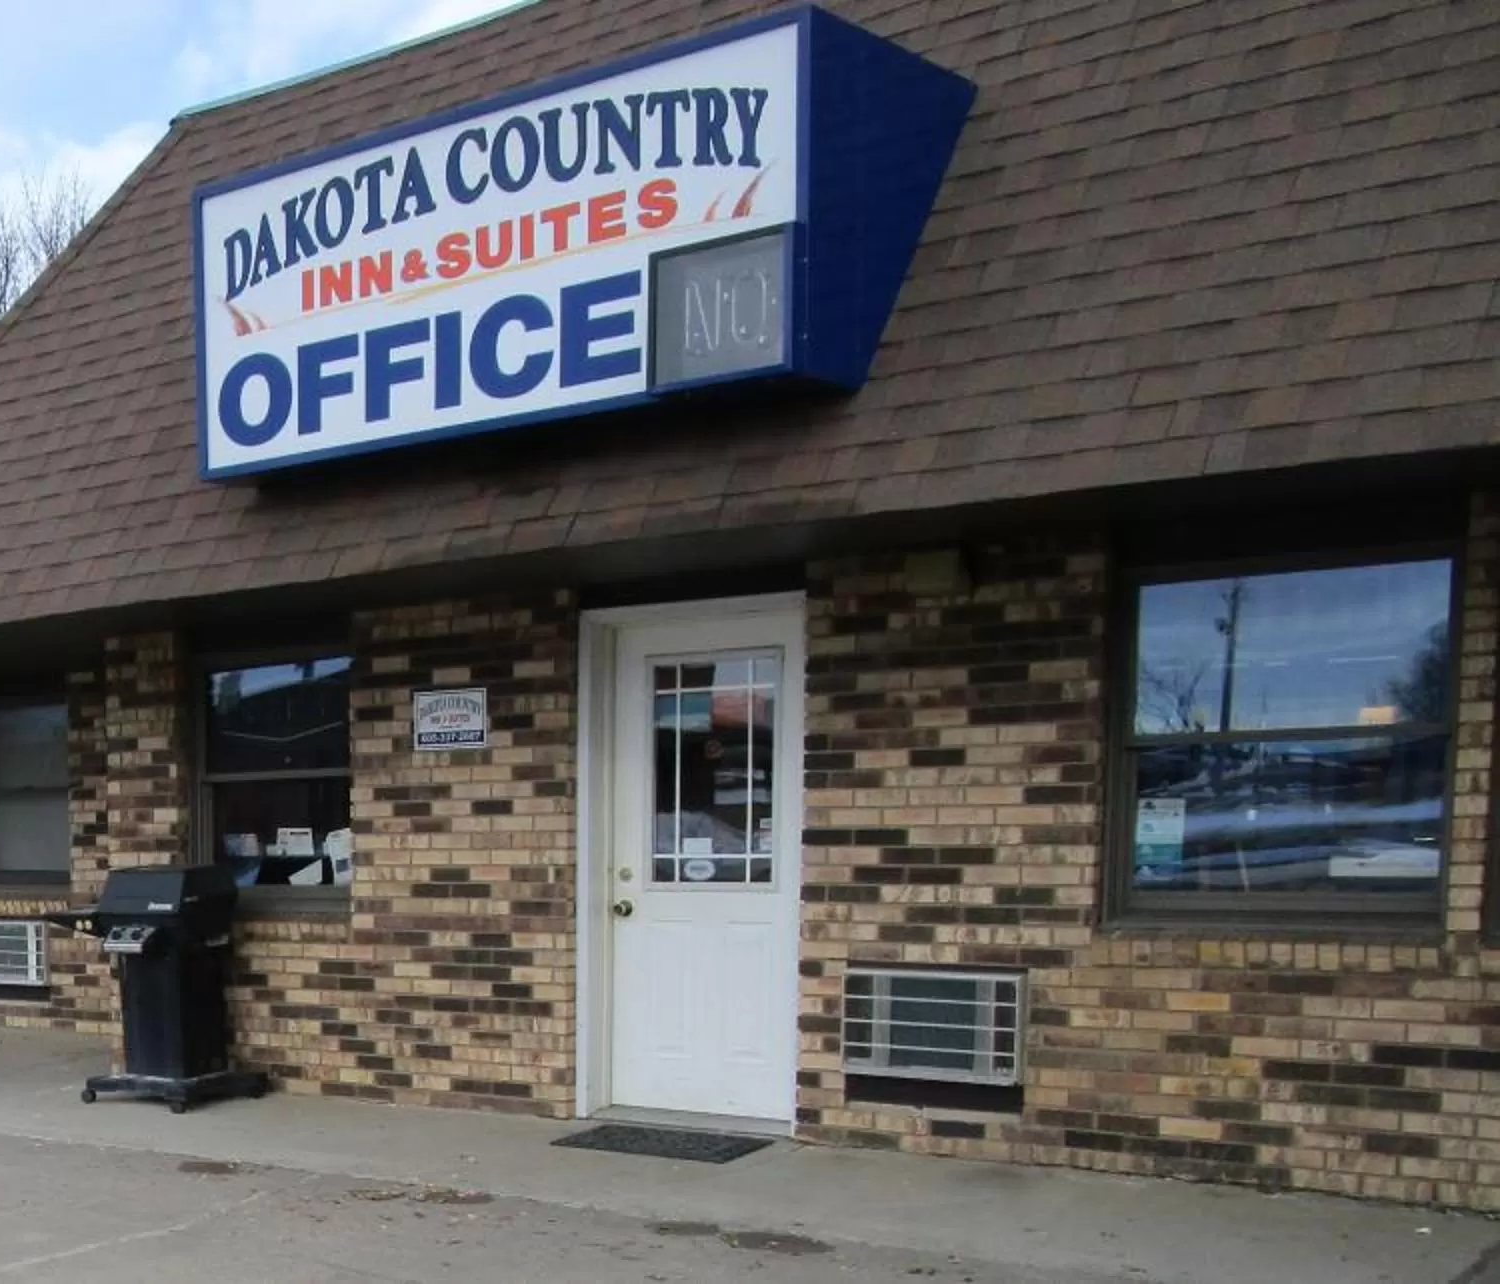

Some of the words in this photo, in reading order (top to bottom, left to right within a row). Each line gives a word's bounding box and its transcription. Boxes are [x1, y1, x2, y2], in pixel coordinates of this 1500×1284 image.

[224, 147, 436, 301] DAKOTA
[445, 87, 768, 203] COUNTRY
[218, 269, 642, 446] OFFICE
[684, 265, 768, 352] NO
